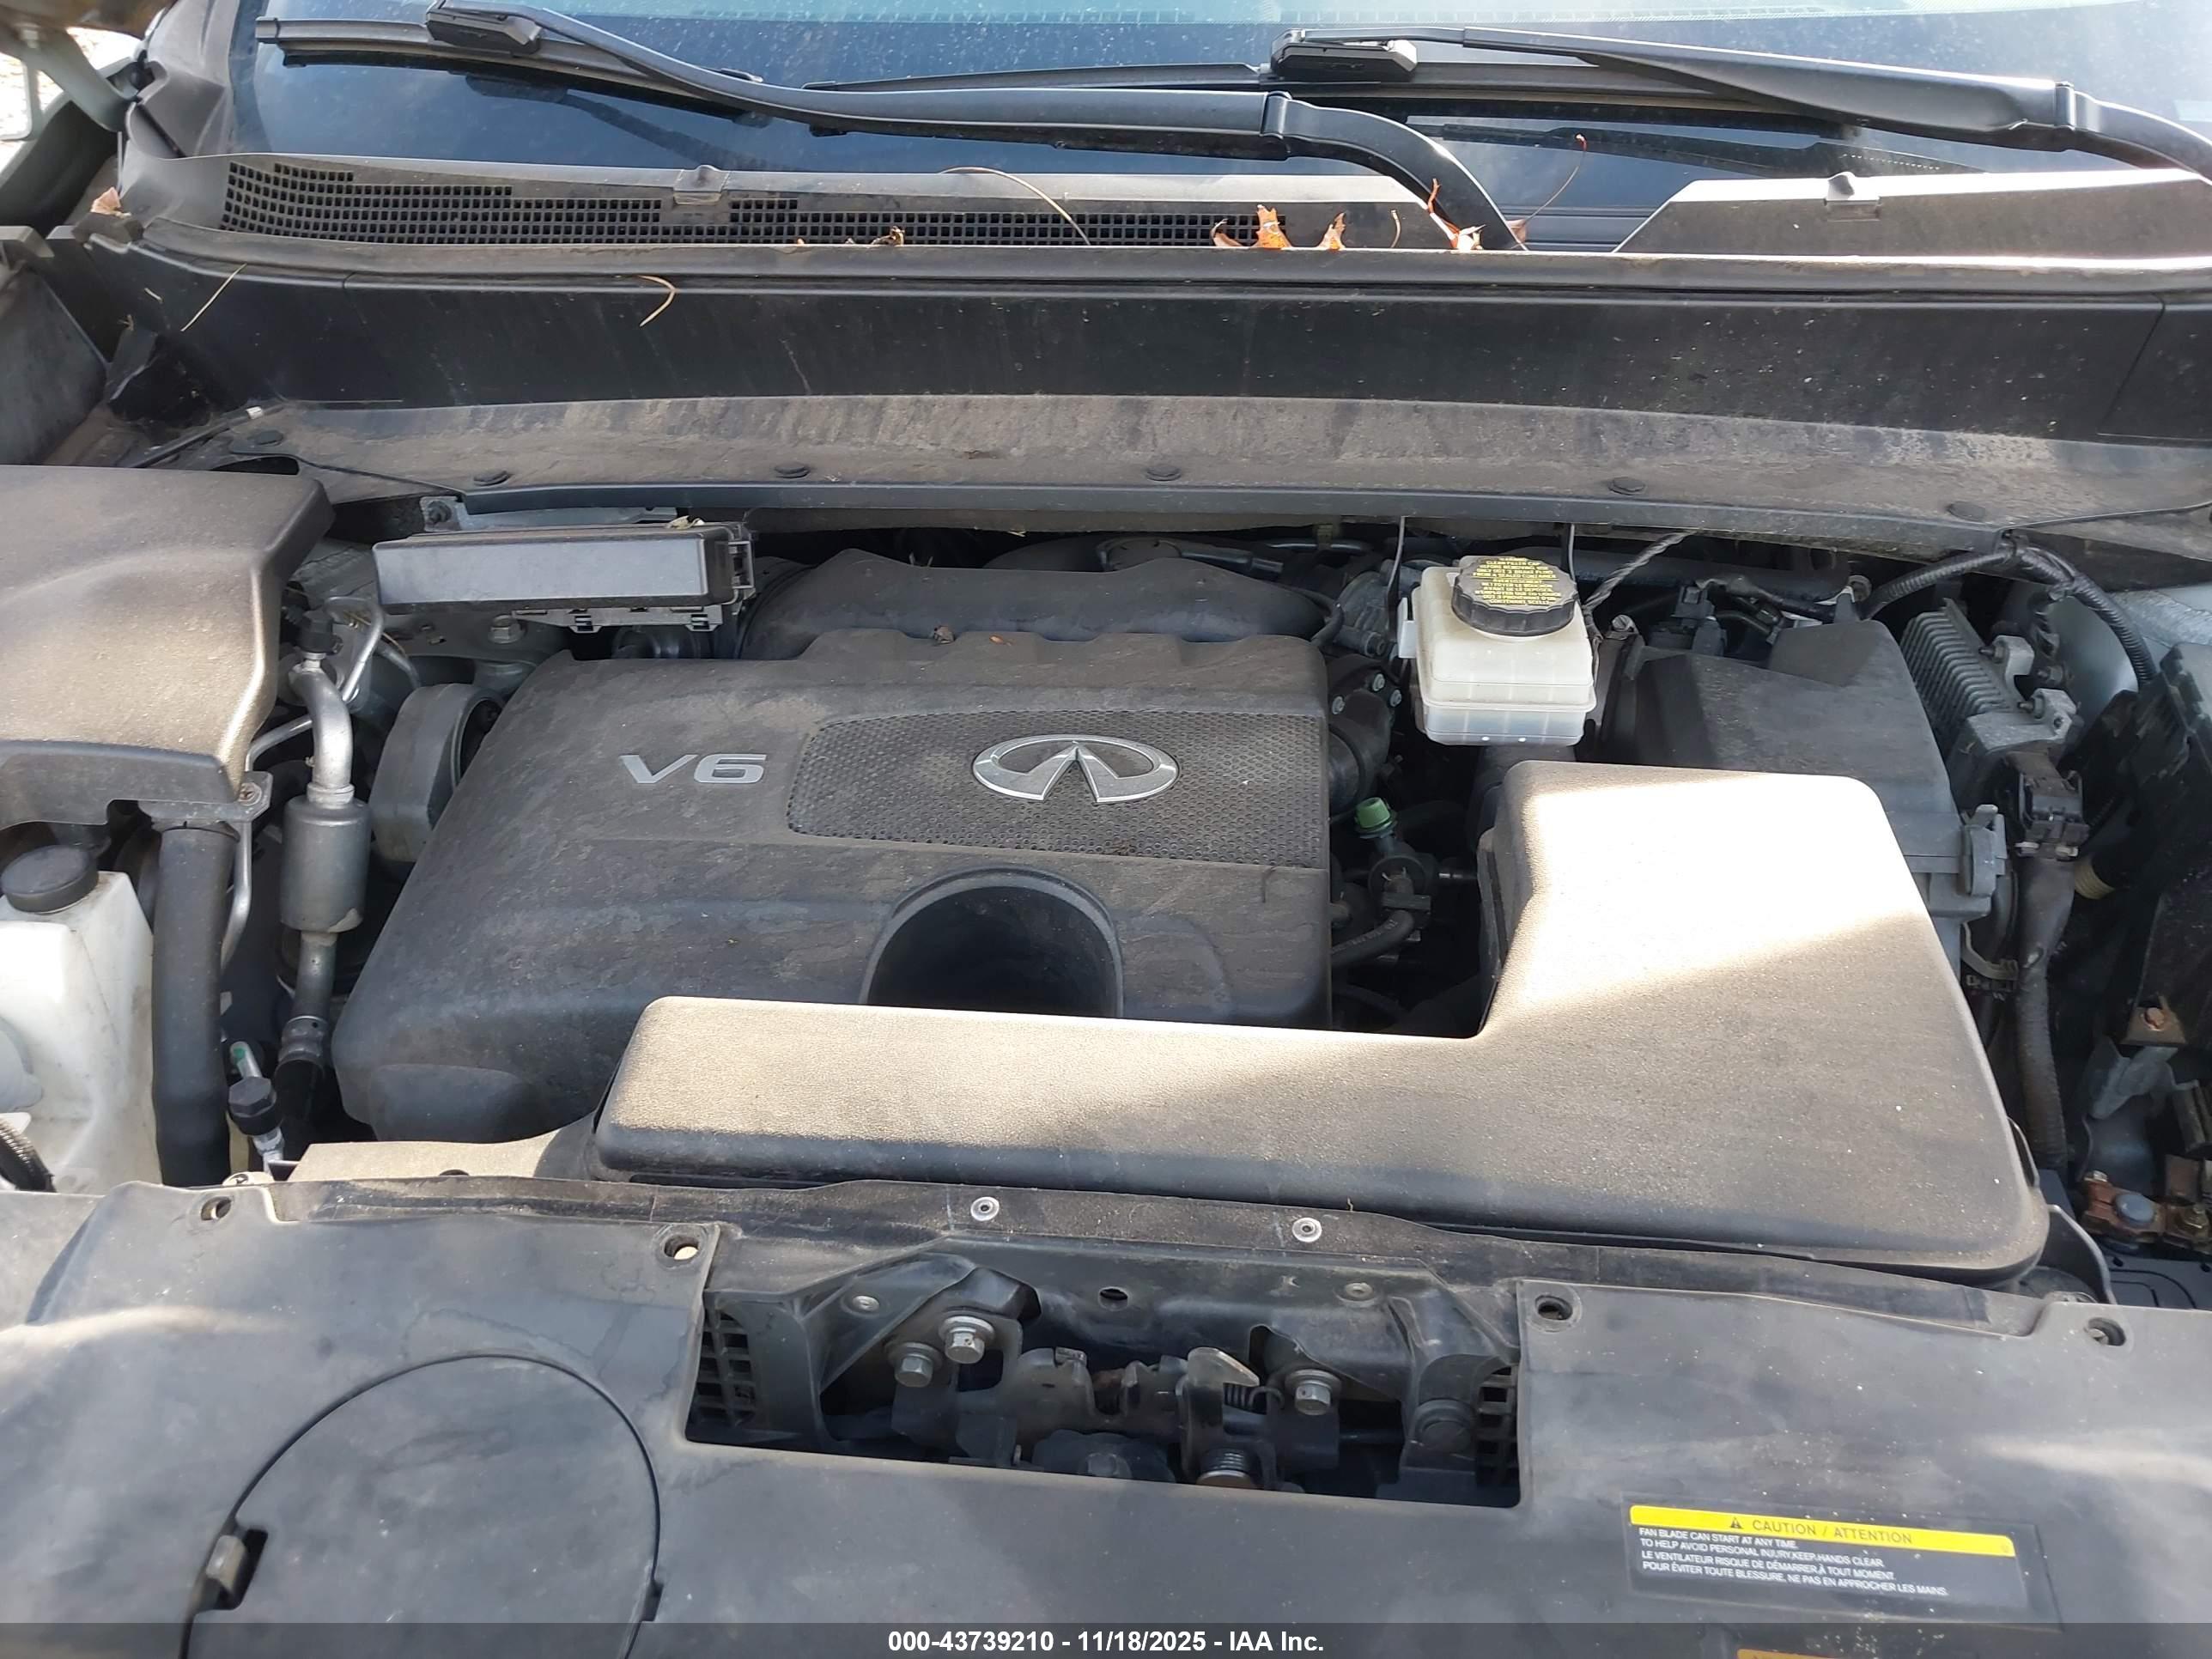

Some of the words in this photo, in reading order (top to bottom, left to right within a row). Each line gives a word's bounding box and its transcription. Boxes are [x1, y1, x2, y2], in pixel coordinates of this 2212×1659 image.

[619, 753, 767, 783] V6
[1638, 1527, 1658, 1537] FAN
[1658, 1528, 1689, 1540] BLADE
[1689, 1531, 1711, 1541] CAN
[1711, 1533, 1740, 1544] START
[1741, 1535, 1753, 1545] AT
[1753, 1536, 1773, 1547] ANY
[1752, 1519, 1816, 1536] CAUTION
[1833, 1527, 1912, 1544] ATTENTION
[1639, 1538, 1654, 1547] TO
[1654, 1539, 1679, 1549] HELP
[1680, 1541, 1708, 1552] AVOID
[1709, 1543, 1759, 1557] PERSONAL
[1641, 1550, 1654, 1559] LE
[1654, 1551, 1714, 1565] VENTILATEUR
[1715, 1556, 1750, 1568] RISQUE
[1751, 1559, 1765, 1570] DE
[1827, 1565, 1851, 1577] TOUT
[1642, 1560, 1670, 1571] POUR
[1671, 1561, 1703, 1575] ÉVITER
[1703, 1565, 1734, 1577] TOUTE
[1787, 1573, 1801, 1583] NE
[1802, 1574, 1821, 1586] PAS
[1822, 1577, 1838, 1588] EN
[1896, 1583, 1916, 1594] LES
